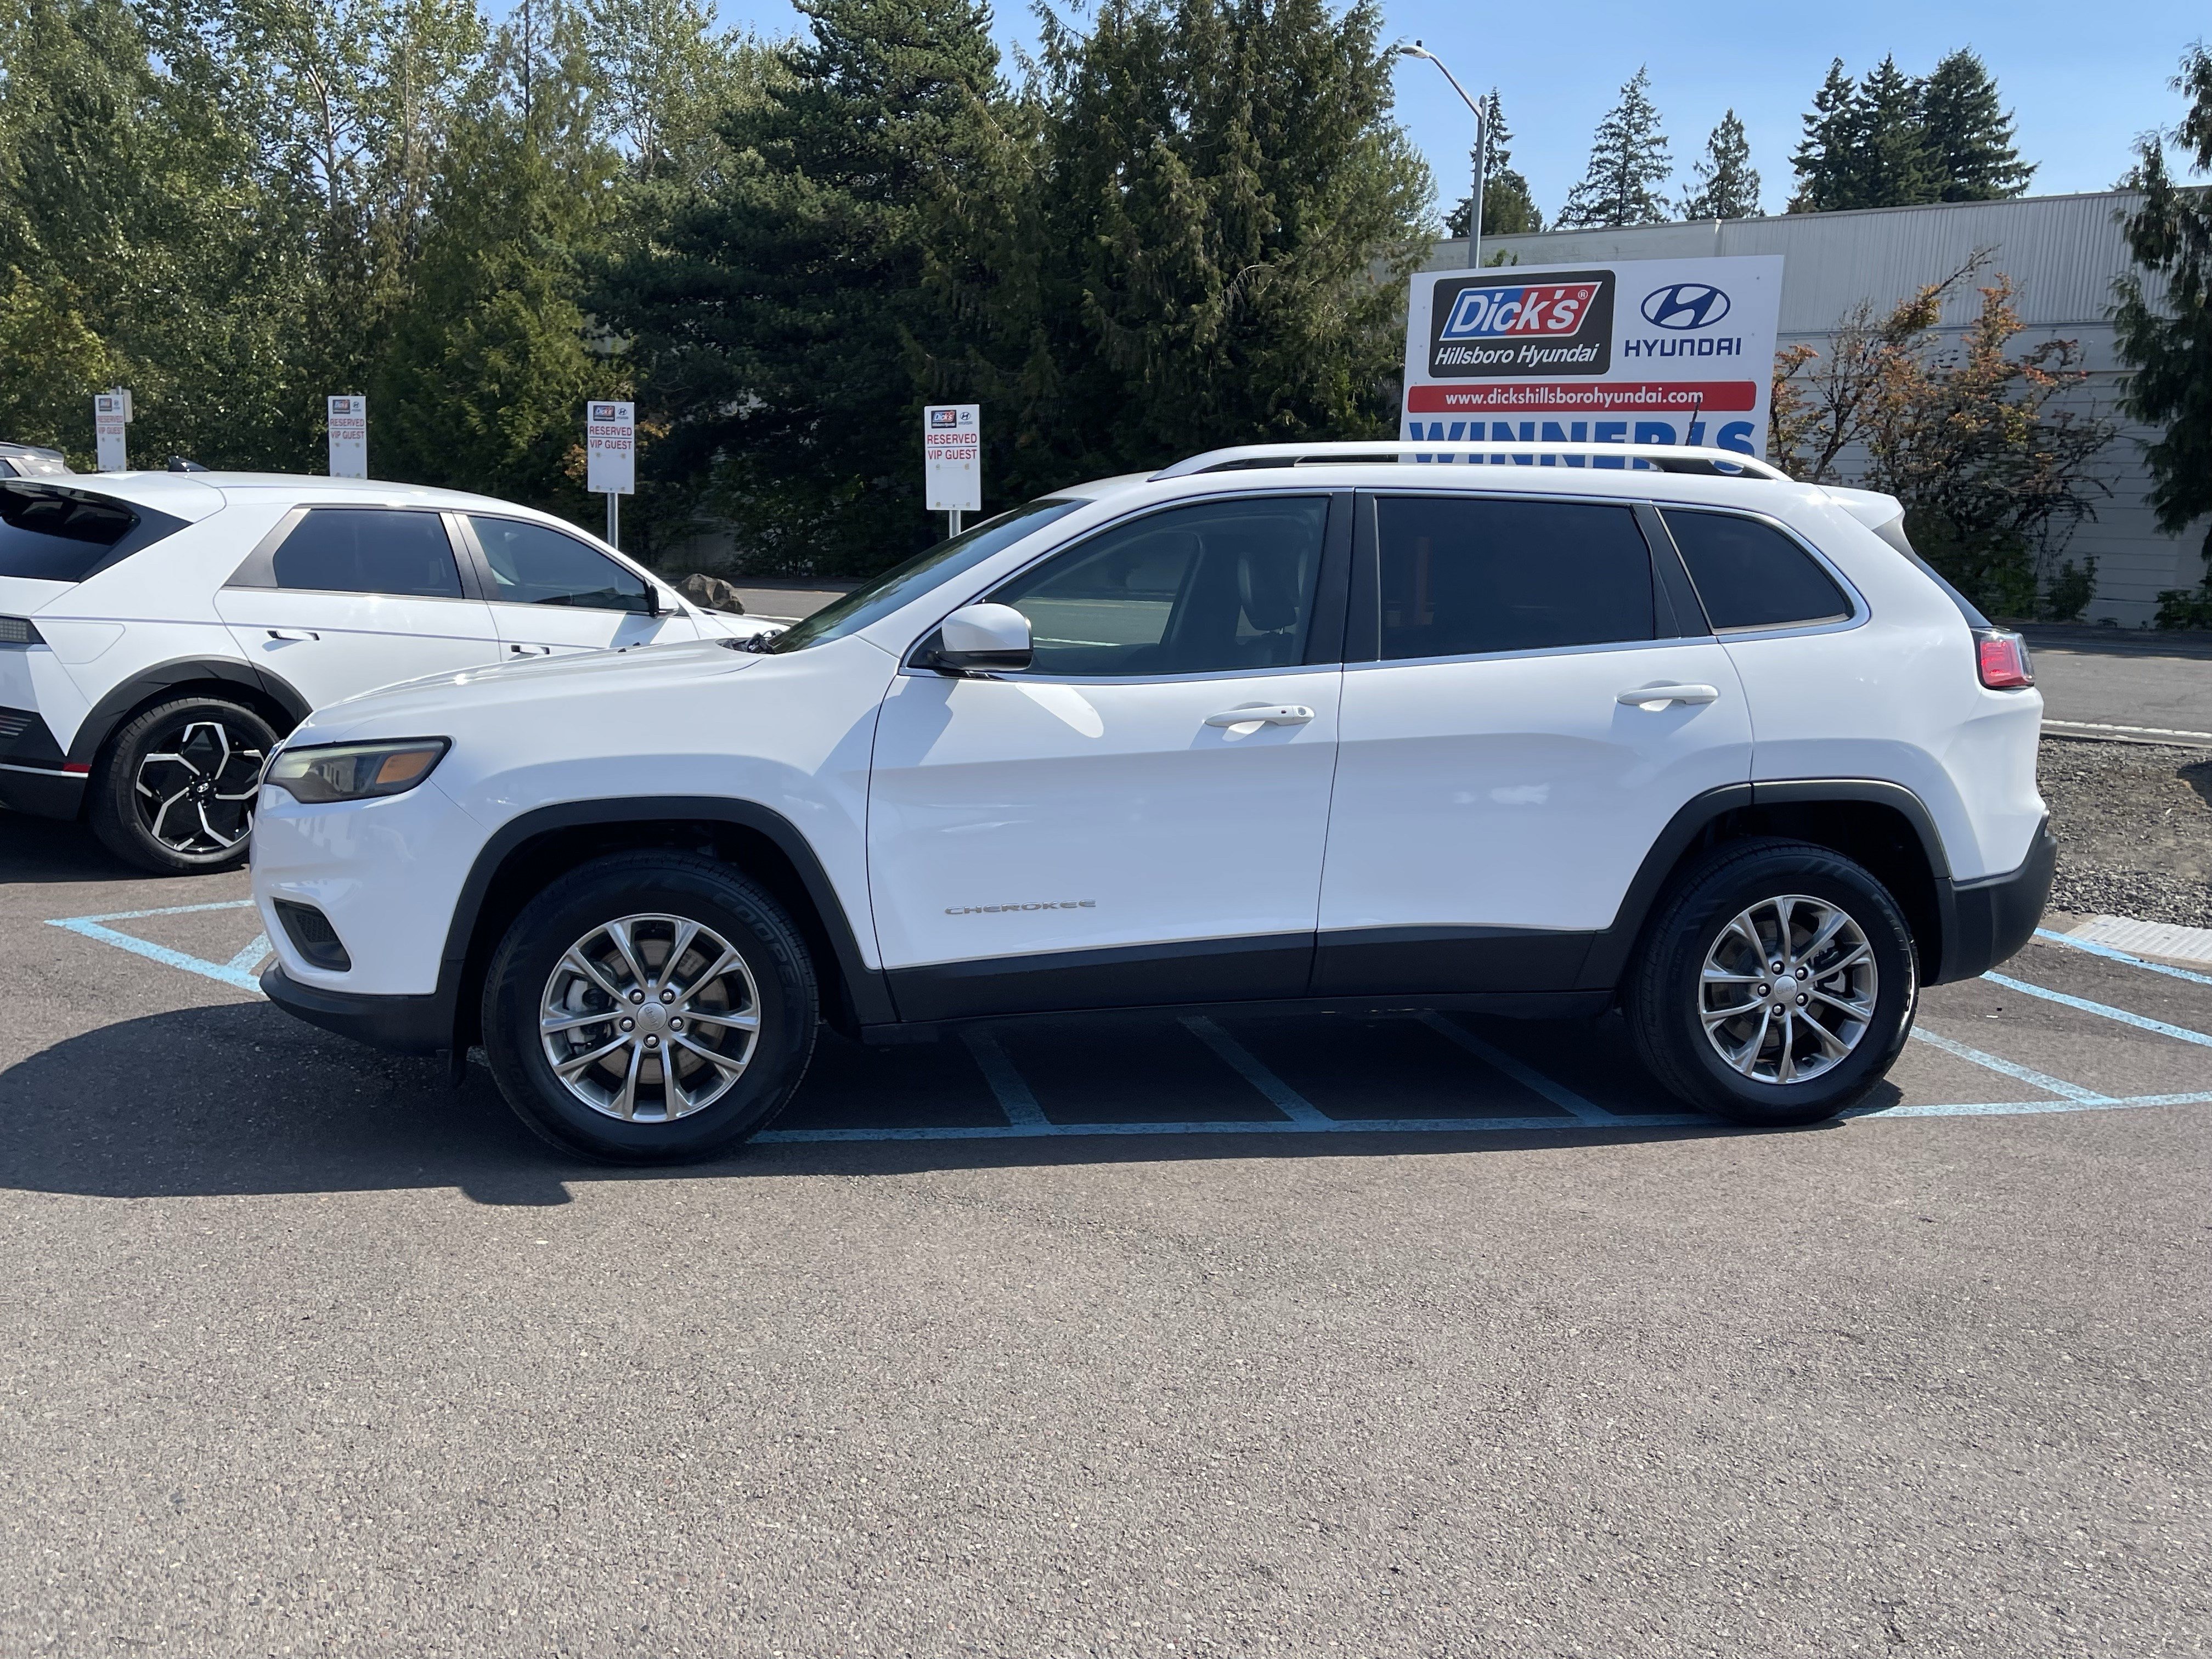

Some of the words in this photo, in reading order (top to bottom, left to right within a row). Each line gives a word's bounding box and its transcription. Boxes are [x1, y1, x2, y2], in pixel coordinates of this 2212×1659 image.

[1624, 338, 1741, 357] HYUNDAI
[1435, 345, 1515, 365] Hillsboro
[1517, 343, 1600, 368] Hyundai
[1446, 386, 1703, 408] www.dickshillsborohyundai.com
[330, 418, 365, 427] RESERVED
[330, 431, 341, 439] VIP
[342, 431, 364, 439] GUEST
[589, 426, 632, 436] RESERVED
[590, 439, 602, 448] VIP
[605, 440, 632, 449] GUEST
[927, 433, 977, 444] RESERVED
[928, 450, 943, 460] VIP
[945, 449, 977, 459] GUEST
[945, 899, 1096, 915] CHEROKEE
